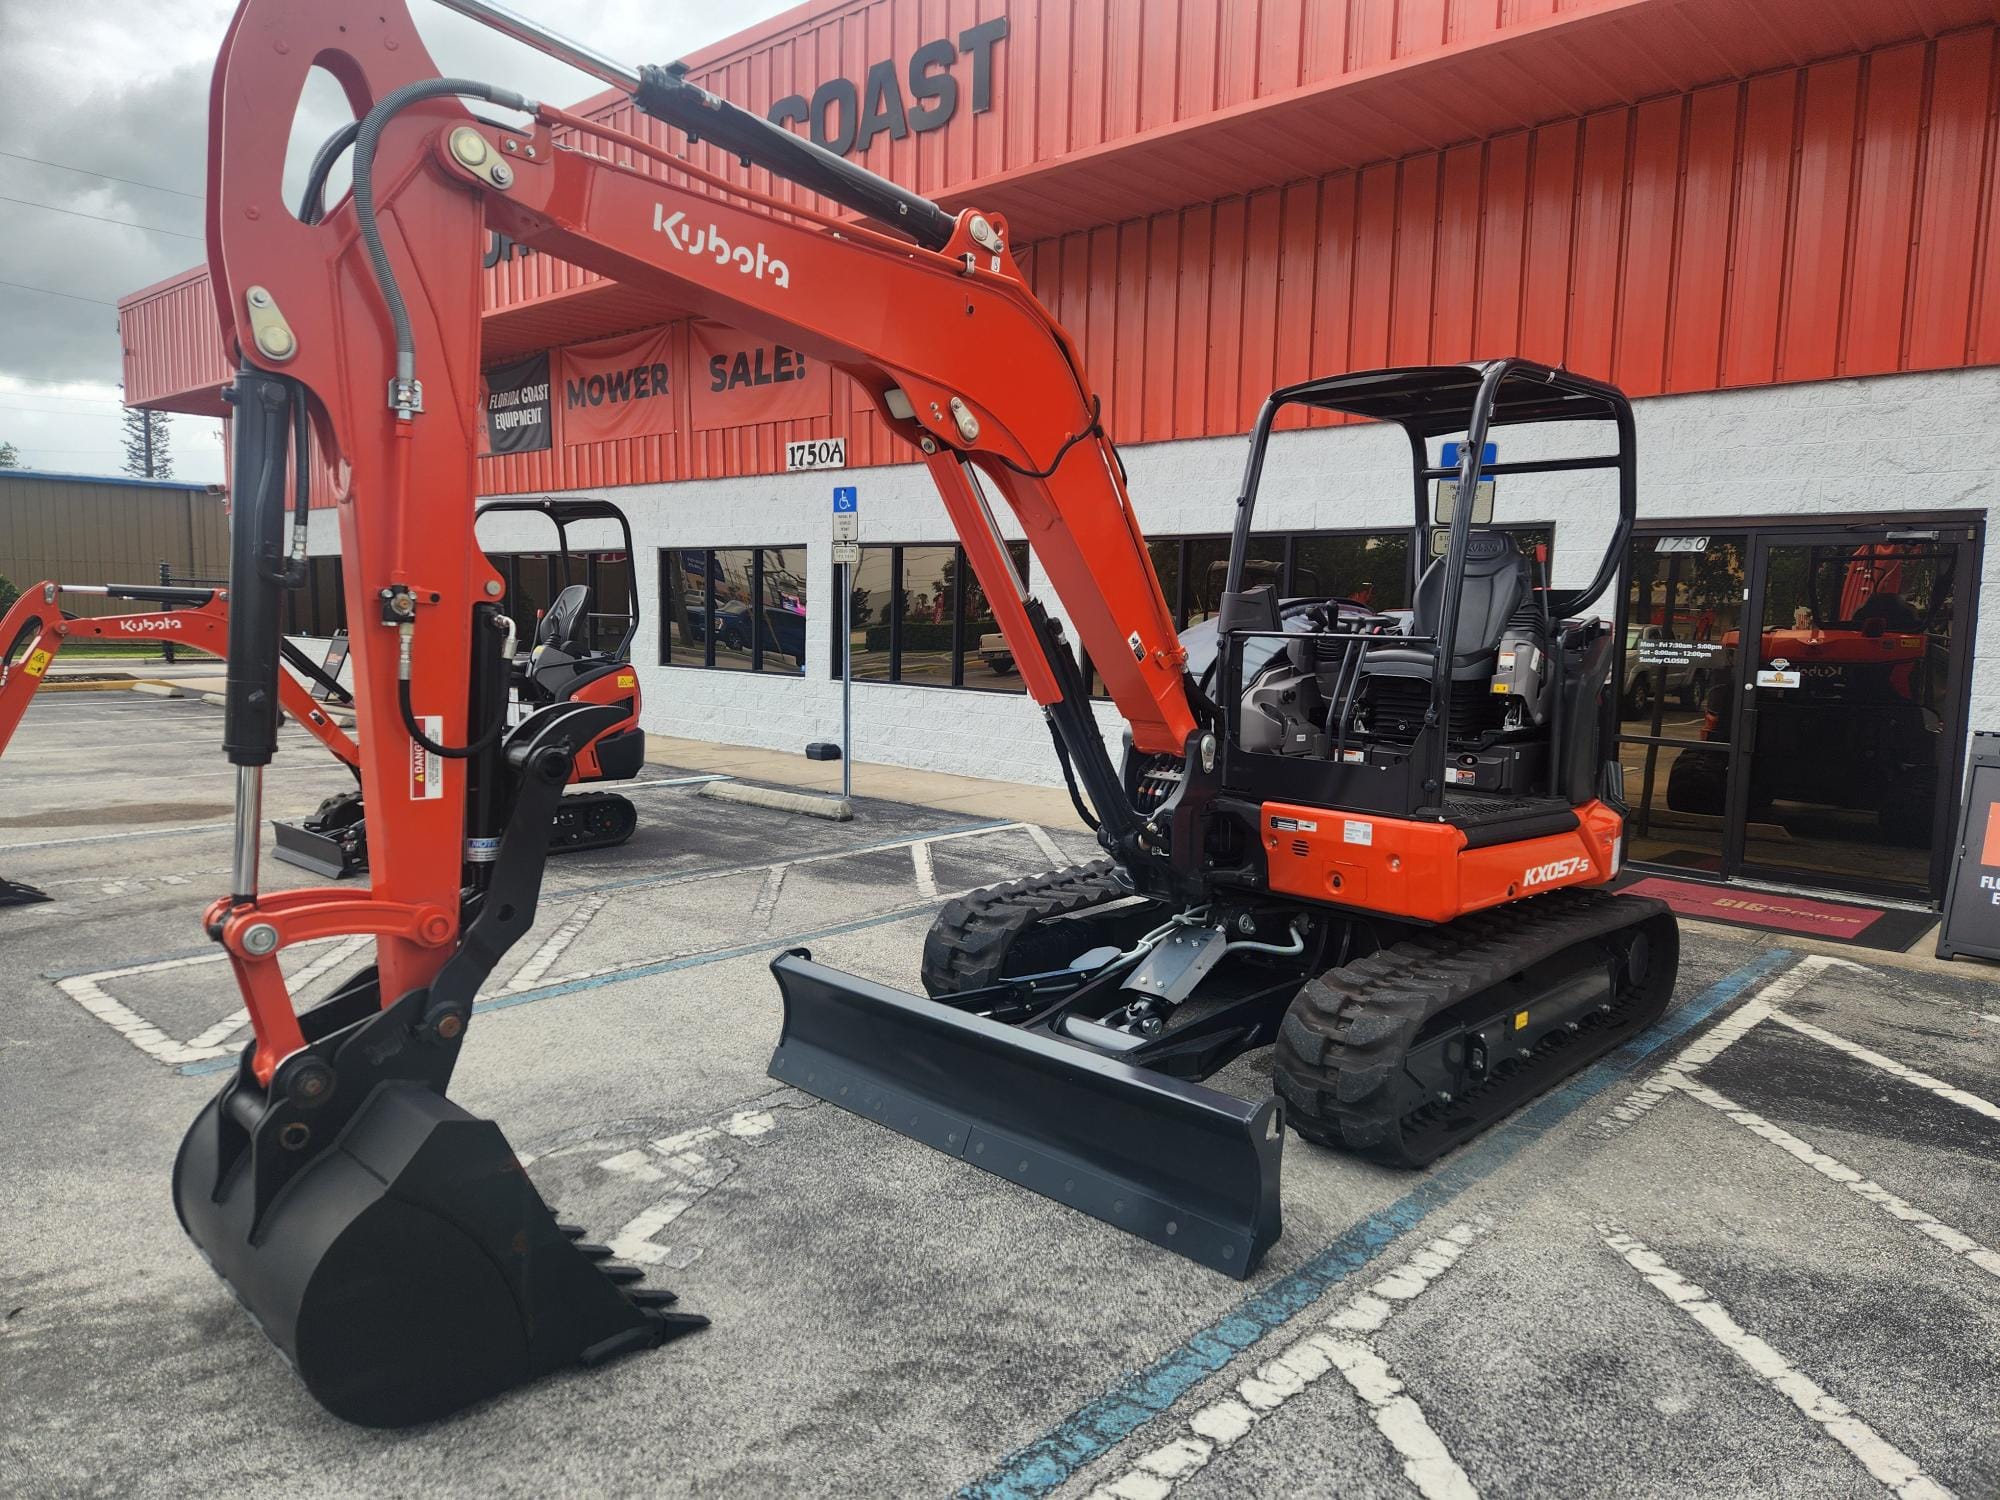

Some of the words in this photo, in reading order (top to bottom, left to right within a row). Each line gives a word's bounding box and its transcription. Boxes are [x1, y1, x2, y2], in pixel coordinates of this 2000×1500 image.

[653, 202, 789, 289] Kubota
[709, 345, 806, 392] SALE!
[489, 389, 520, 409] FLORIDA
[521, 383, 549, 404] COAST
[567, 363, 669, 409] MOWER
[495, 407, 542, 430] EQUIPMENT
[789, 441, 843, 466] 1750A
[1660, 537, 1707, 550] 1750
[120, 617, 181, 632] Kubota
[1523, 857, 1589, 887] KX057-5
